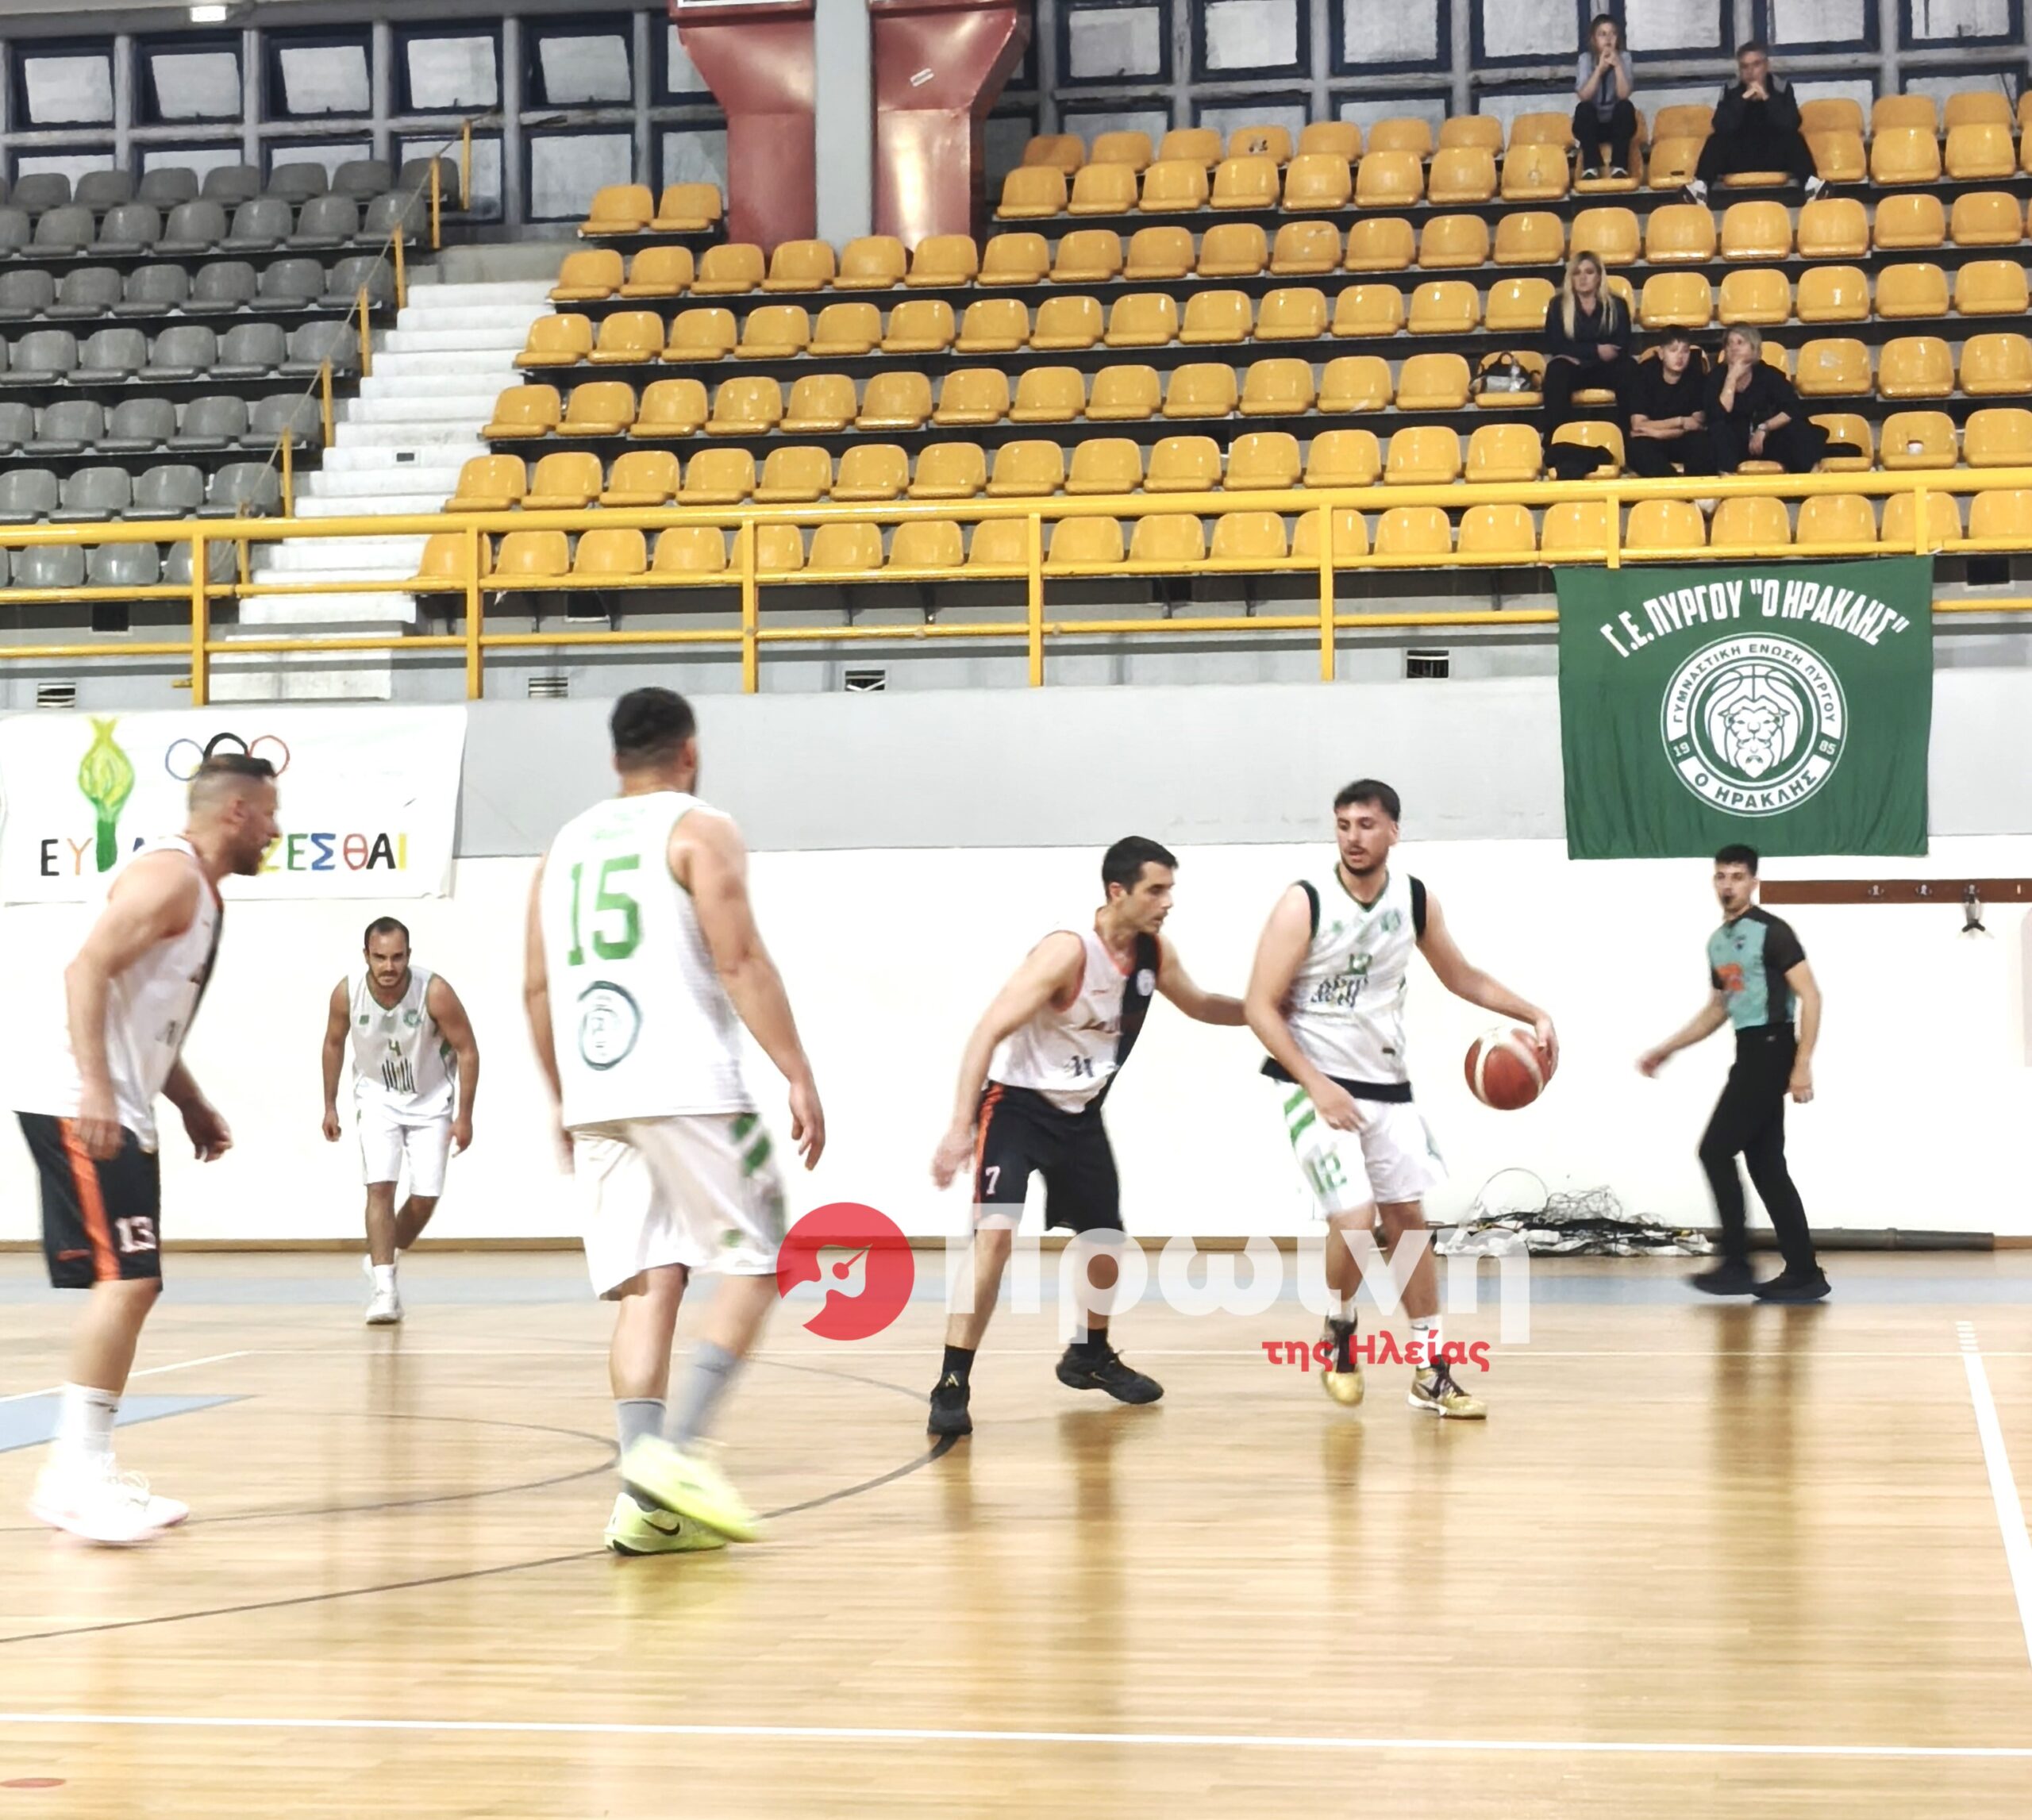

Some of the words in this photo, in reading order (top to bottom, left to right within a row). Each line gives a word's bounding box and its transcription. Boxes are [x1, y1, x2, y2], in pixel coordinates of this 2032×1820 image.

[1642, 579, 1743, 637] ΠΥΡΓΟΥ
[1781, 579, 1910, 646] ΗΡΑΚΛΗΣ"
[1672, 645, 1741, 724] ΓΥΜΝΑΣΤΙΚΗ
[1749, 643, 1803, 665] ΕΝΩΣΗ
[1804, 664, 1836, 723] ΠΥΡΓΟΥ
[1672, 741, 1691, 757] 19
[1694, 772, 1710, 787] Ο
[1714, 769, 1818, 809] ΗΡΑΚΛΗΣ
[567, 853, 644, 967] 15
[387, 1037, 402, 1056] 4
[984, 1165, 1001, 1195] 7
[115, 1215, 157, 1253] 13
